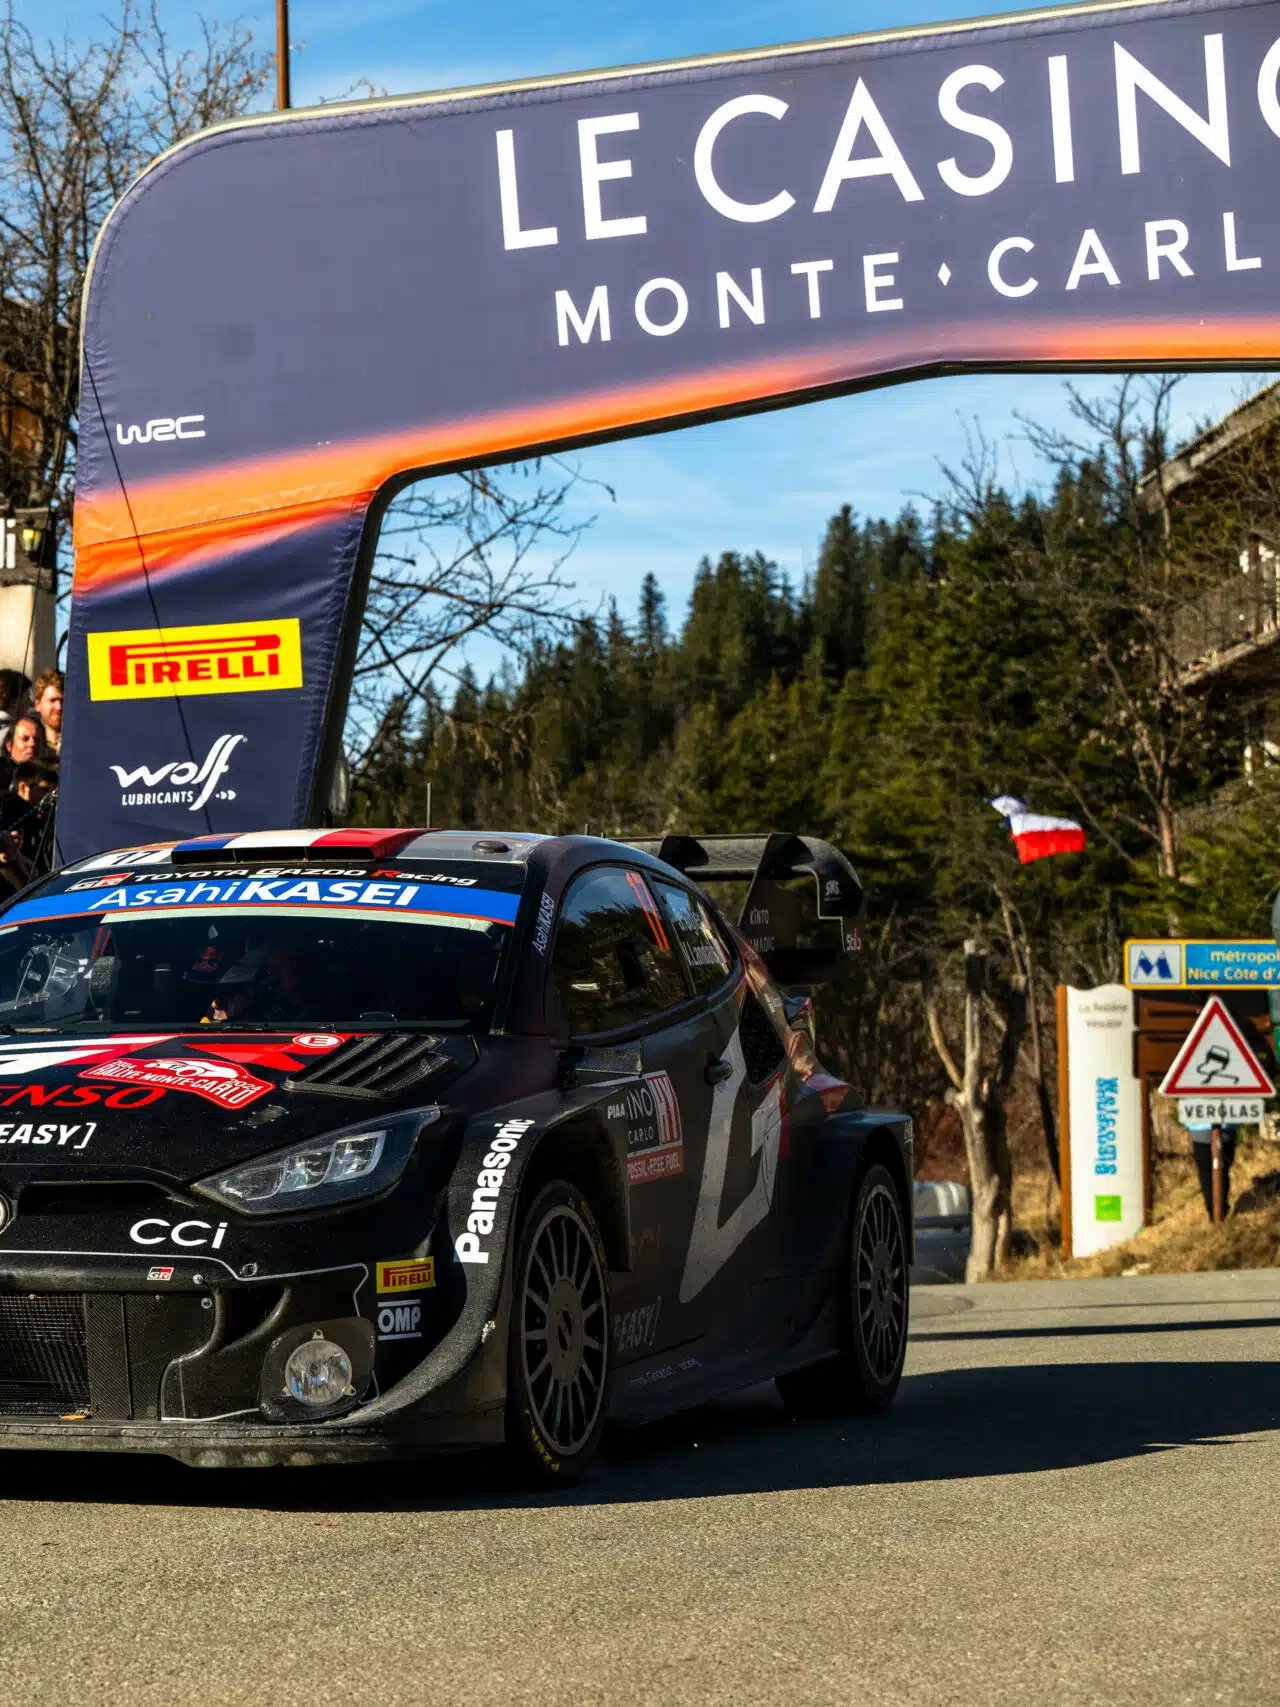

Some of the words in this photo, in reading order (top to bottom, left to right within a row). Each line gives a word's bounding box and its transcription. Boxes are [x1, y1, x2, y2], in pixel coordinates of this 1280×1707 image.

[495, 112, 648, 250] LE
[694, 33, 1280, 224] CASIN
[556, 251, 905, 347] MONTE
[987, 211, 1262, 298] CARL
[116, 414, 206, 445] WRC
[108, 634, 281, 687] PIRELLI
[121, 790, 194, 806] LUBRICANTS
[134, 869, 250, 883] TOYOTA
[374, 869, 478, 886] Racing
[1210, 950, 1280, 967] métropol
[1188, 967, 1219, 980] Nice
[1224, 966, 1258, 980] Côte
[607, 1103, 626, 1120] PIAA
[1184, 1104, 1261, 1118] VERGLAS
[453, 1117, 536, 1264] Panasonic
[149, 1269, 173, 1280] GR
[382, 1262, 433, 1288] PIRELLI
[377, 1306, 421, 1334] OMP
